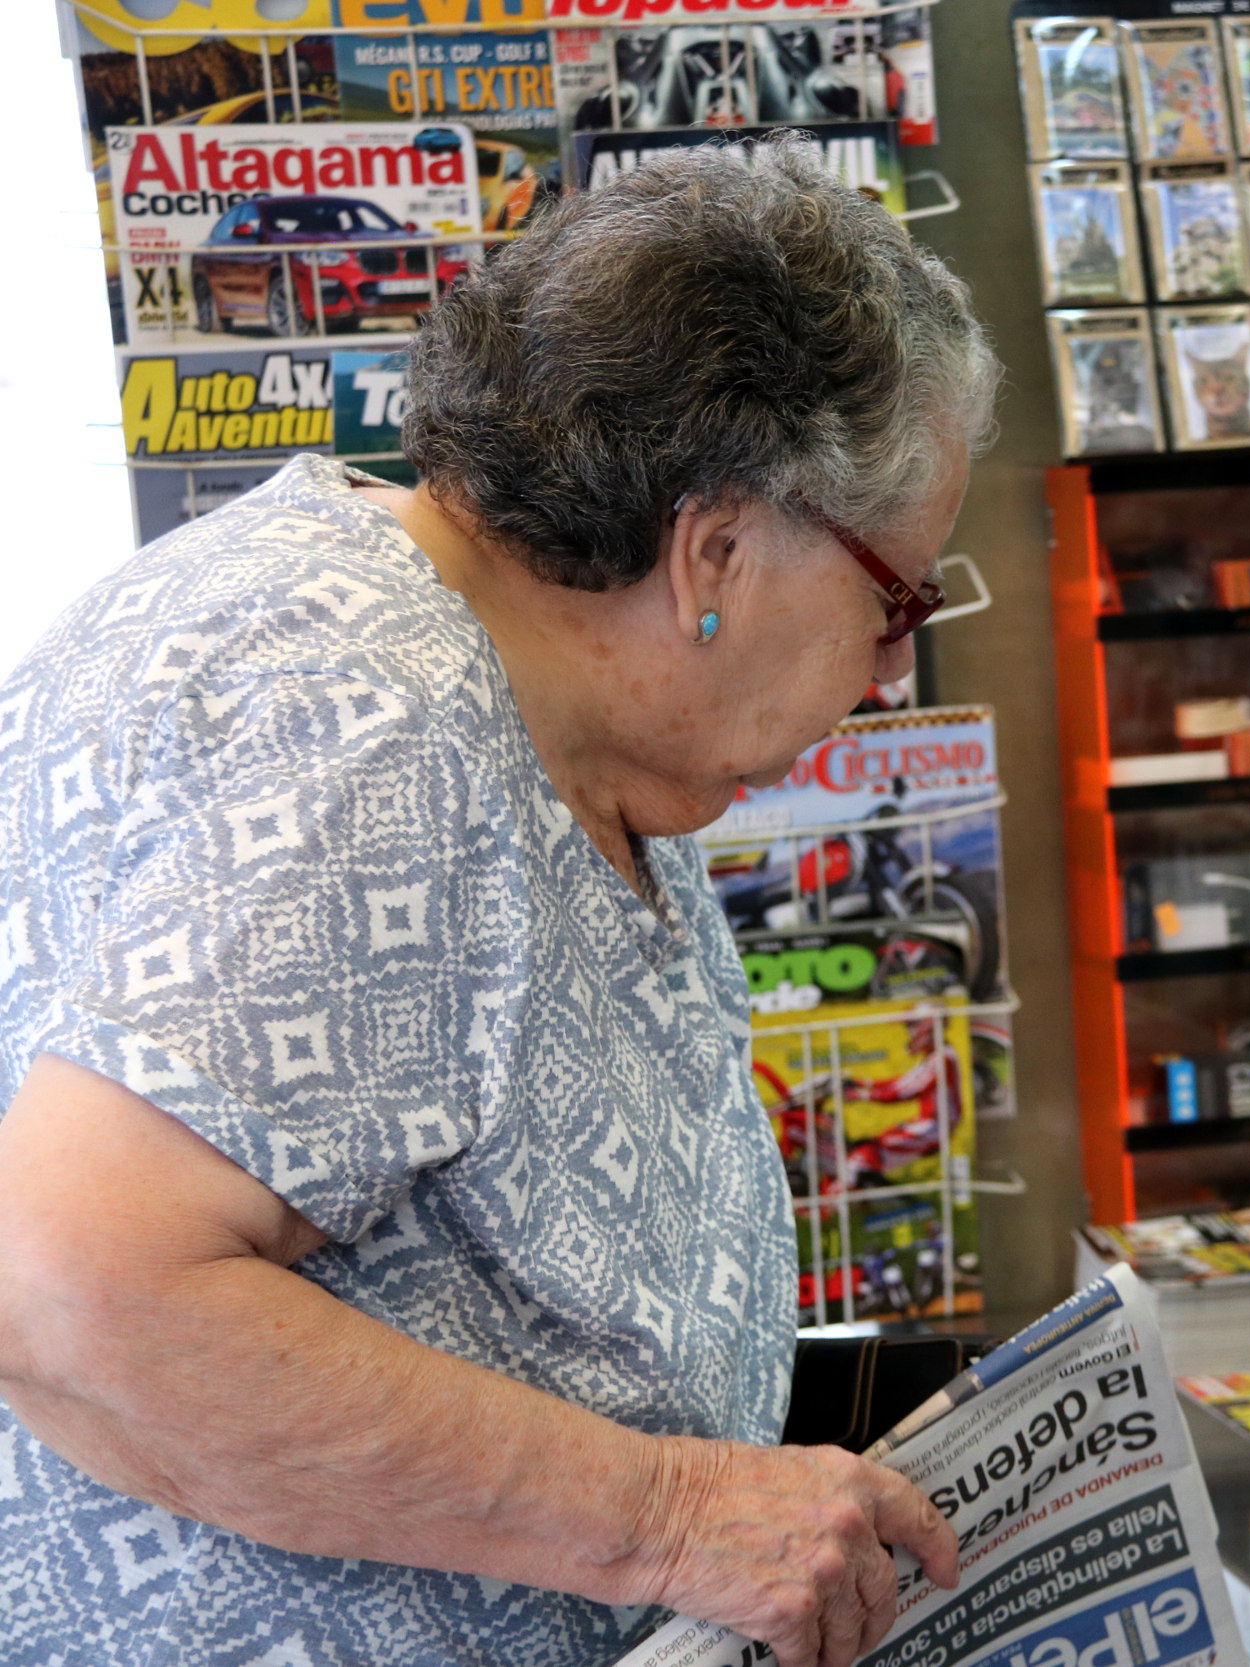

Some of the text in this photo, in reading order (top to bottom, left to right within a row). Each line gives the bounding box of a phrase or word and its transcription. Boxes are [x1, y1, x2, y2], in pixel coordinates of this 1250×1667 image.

[355, 42, 412, 65] MÉGAN
[1058, 1348, 1116, 1380] Govern
[1117, 1343, 1132, 1358] El
[930, 1363, 1149, 1520] la defens
[958, 1410, 1158, 1554] Sánchez
[1075, 1452, 1164, 1500] DEMANDA
[1051, 1495, 1074, 1514] DE
[1108, 1500, 1177, 1537] Vella
[1070, 1531, 1104, 1555] es
[1146, 1526, 1184, 1558] La
[971, 1545, 1066, 1611] dispara
[971, 1541, 1142, 1637] delinqüència
[934, 1608, 967, 1636] un
[951, 1629, 968, 1650] a
